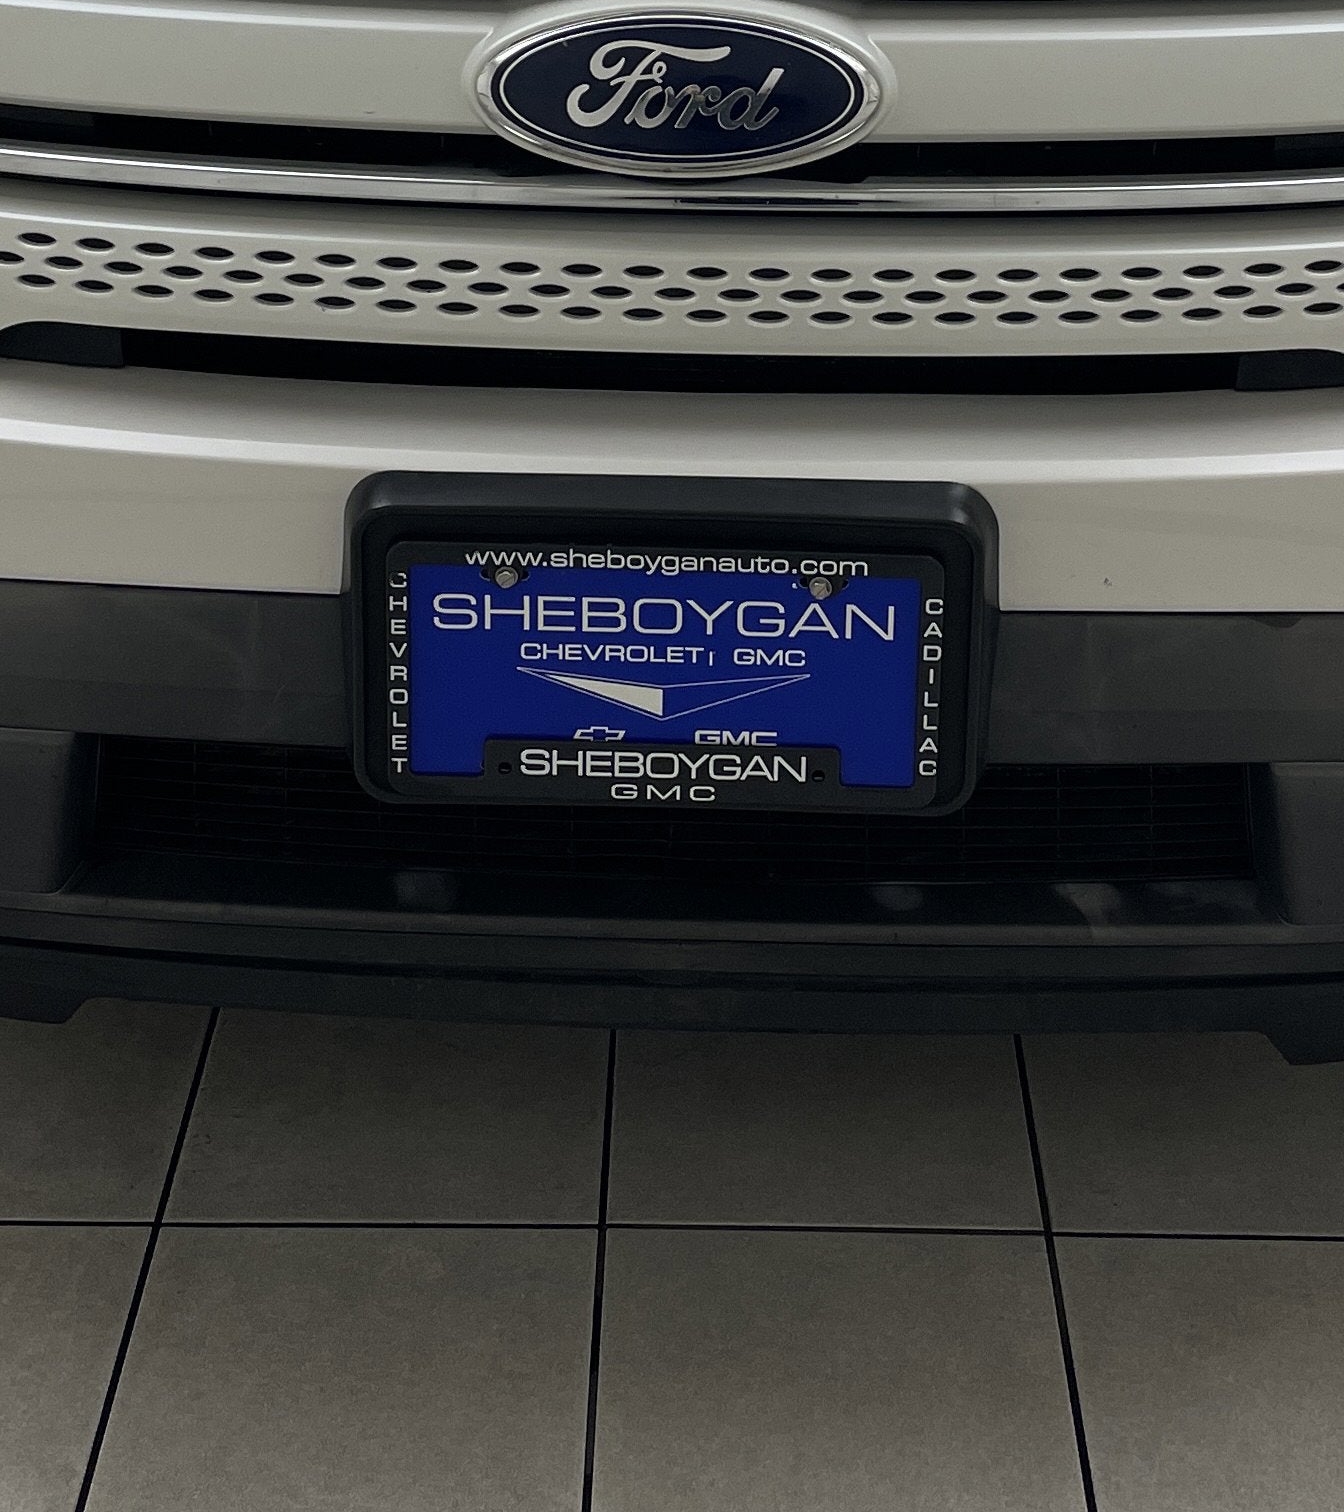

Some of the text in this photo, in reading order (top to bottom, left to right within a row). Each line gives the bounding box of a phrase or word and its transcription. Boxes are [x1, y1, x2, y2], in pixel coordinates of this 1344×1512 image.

[566, 39, 785, 131] Ford
[464, 548, 869, 577] www.sheboyganauto.com
[432, 592, 895, 641] SHEBOYGAN
[519, 642, 807, 667] CHEVROLET GMC
[389, 572, 409, 773] CHEVROLET
[918, 598, 944, 777] CADILLAC
[694, 729, 778, 747] GMC
[519, 748, 807, 783] SHEBOYGAN
[610, 783, 716, 802] GMC
